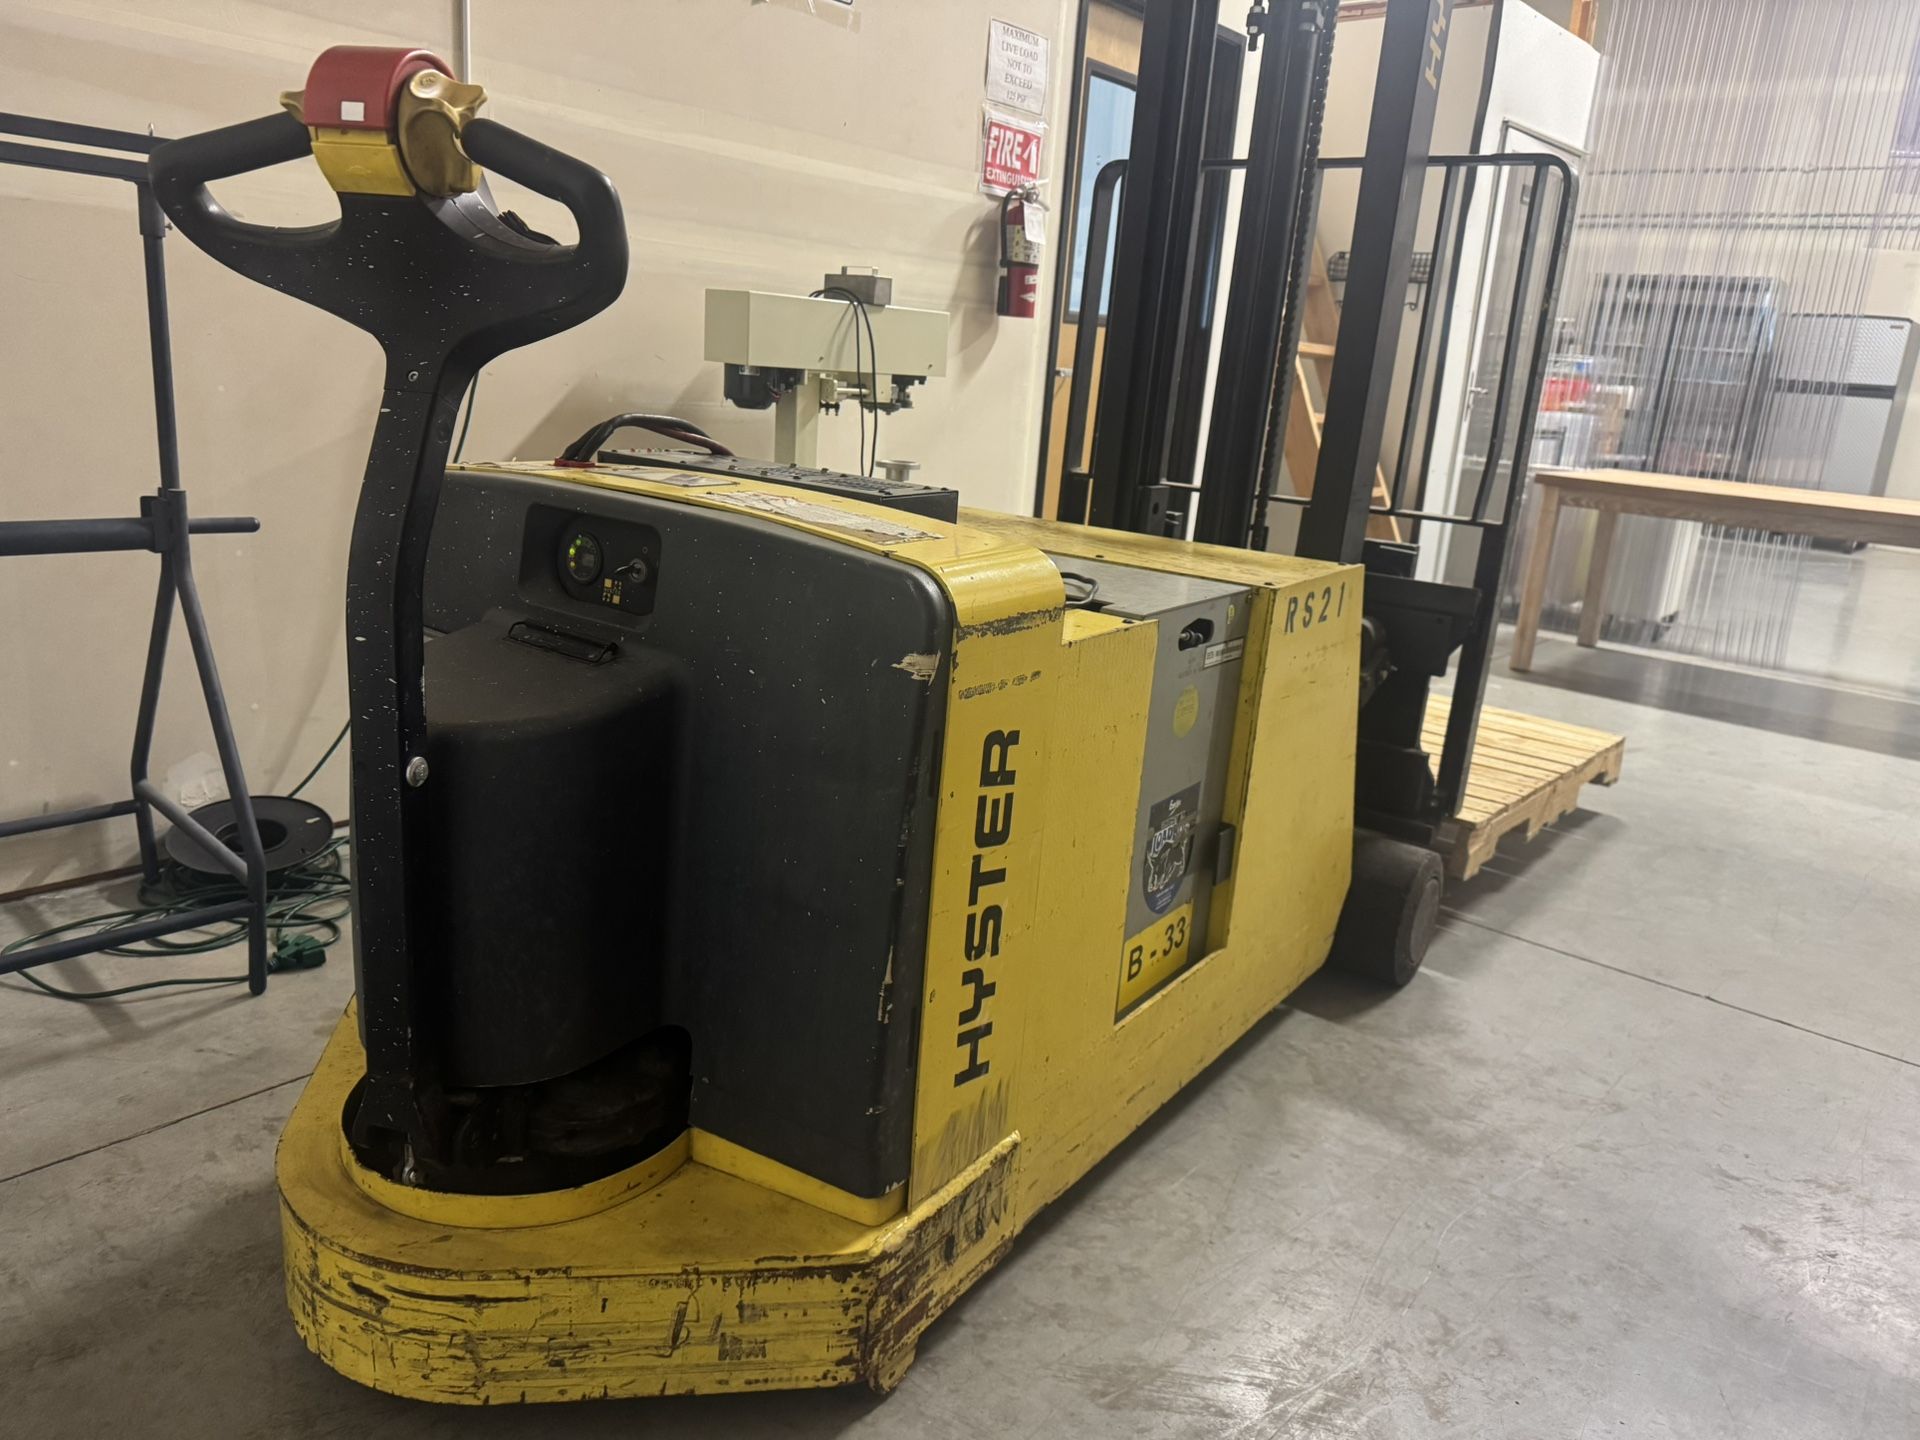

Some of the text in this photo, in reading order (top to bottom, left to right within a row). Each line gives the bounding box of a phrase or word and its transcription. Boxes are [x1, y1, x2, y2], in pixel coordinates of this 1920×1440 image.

[1002, 26, 1039, 47] MAXIMUM
[1001, 41, 1038, 61] LIVE LOAD
[1007, 58, 1032, 75] NOT TO
[1004, 73, 1032, 89] EXCEED
[987, 126, 1024, 170] FIRE
[1284, 581, 1345, 634] RS21
[954, 729, 1020, 1088] HYSTER
